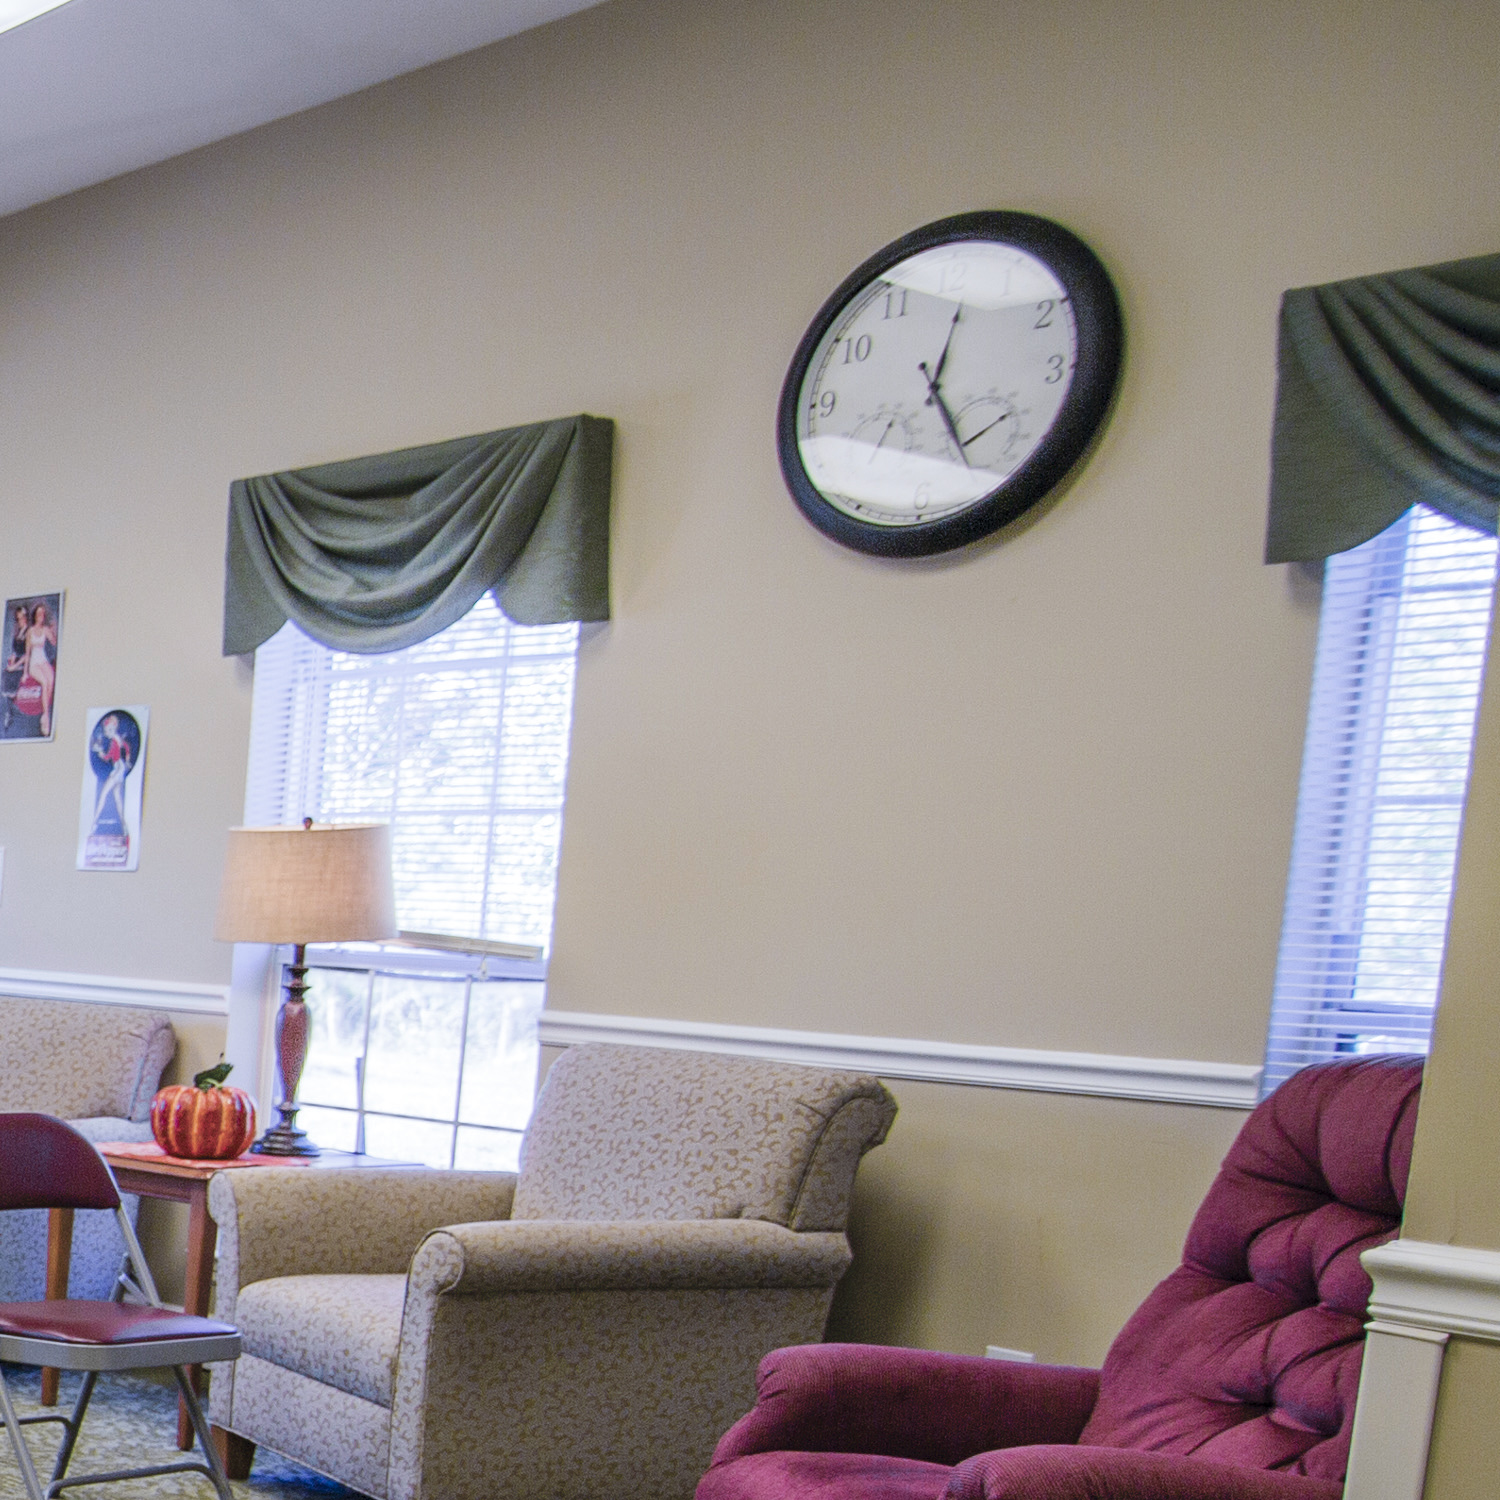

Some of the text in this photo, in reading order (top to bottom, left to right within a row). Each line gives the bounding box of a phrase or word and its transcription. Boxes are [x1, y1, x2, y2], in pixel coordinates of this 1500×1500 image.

[937, 262, 967, 294] 12
[1001, 269, 1012, 297] 1
[883, 289, 910, 320] 11
[1033, 300, 1055, 330] 2
[841, 334, 872, 365] 10
[1045, 354, 1063, 384] 3
[820, 391, 836, 418] 9
[914, 482, 931, 510] 6
